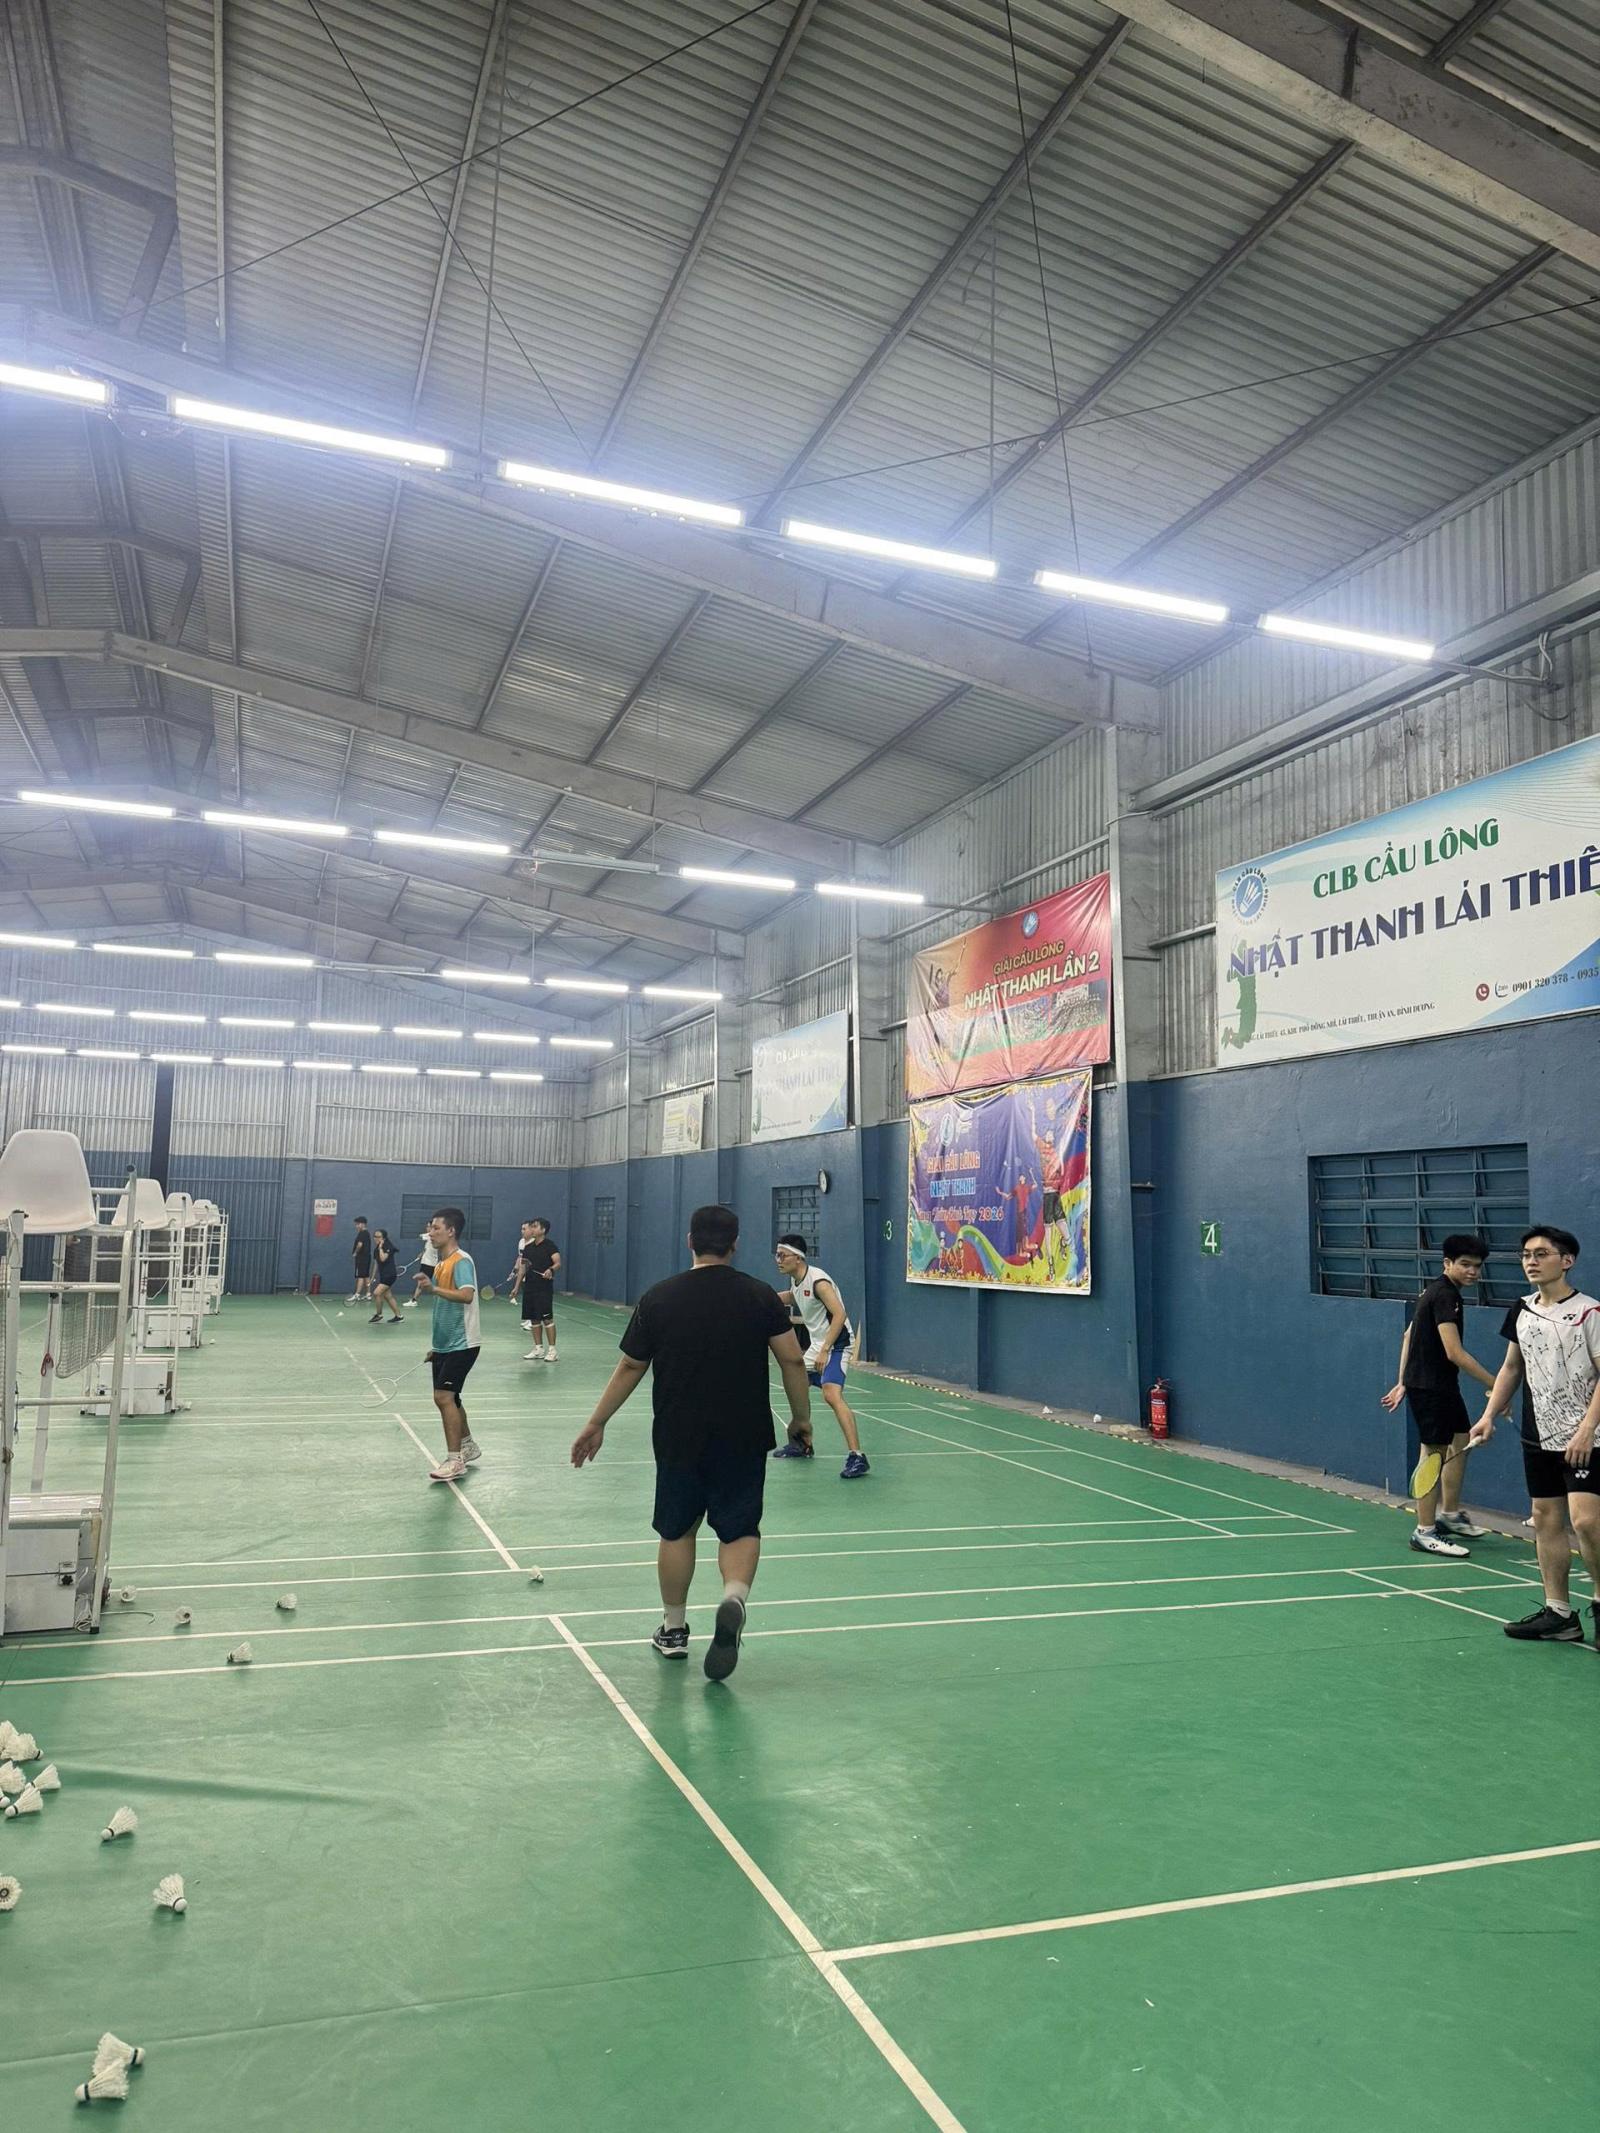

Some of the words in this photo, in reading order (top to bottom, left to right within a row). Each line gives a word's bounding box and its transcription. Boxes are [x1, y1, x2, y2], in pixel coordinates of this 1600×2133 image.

[1313, 864, 1358, 898] CLB
[1364, 841, 1416, 883] CẦU
[1425, 818, 1499, 866] LÔNG
[1231, 928, 1303, 978] NHẬT
[1311, 901, 1424, 960] THANH
[1435, 880, 1491, 930] LÁI
[965, 983, 1000, 1012] NHẬT
[1001, 967, 1050, 1001] THANH
[1053, 950, 1086, 983] LẦN
[1088, 951, 1100, 972] 2
[1512, 980, 1532, 992] 0901
[1534, 977, 1550, 989] 320
[1552, 973, 1568, 984] 378
[886, 1220, 892, 1240] 3
[1204, 1223, 1218, 1253] 4
